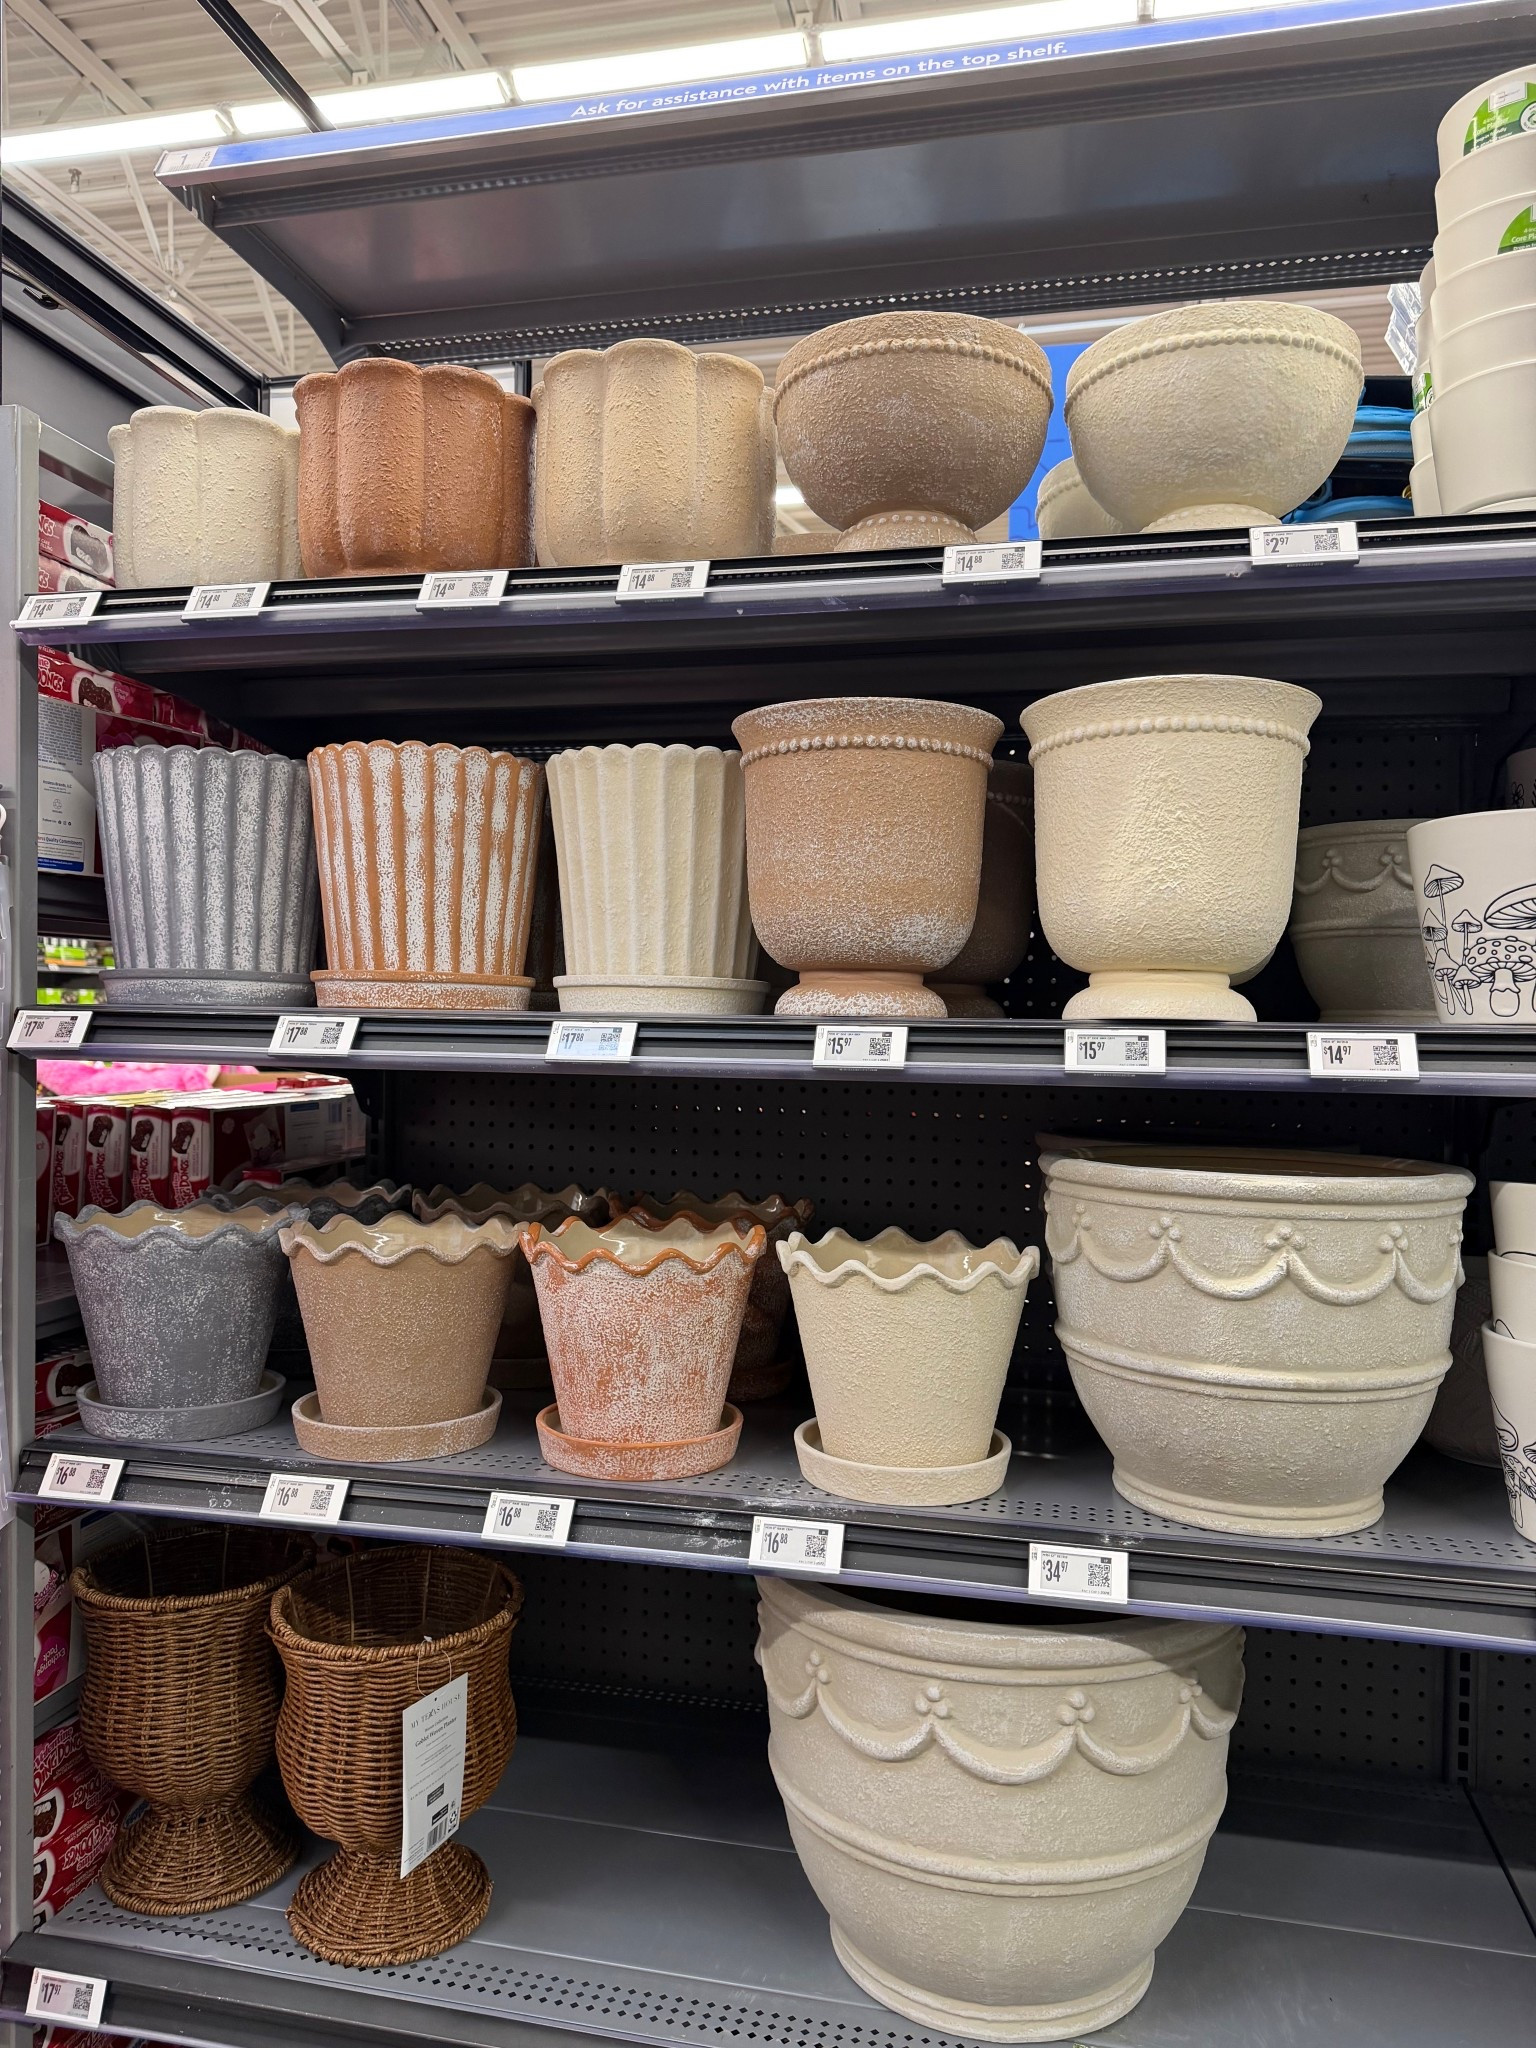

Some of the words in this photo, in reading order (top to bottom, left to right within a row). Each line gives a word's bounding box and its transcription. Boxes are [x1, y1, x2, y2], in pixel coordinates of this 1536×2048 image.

[570, 102, 608, 118] Ask
[615, 96, 645, 112] for
[651, 84, 757, 106] assistance
[763, 71, 810, 92] with
[816, 66, 876, 87] items
[882, 65, 911, 78] on
[917, 55, 955, 73] the
[961, 51, 1001, 71] top
[1006, 41, 1068, 61] shelf.
